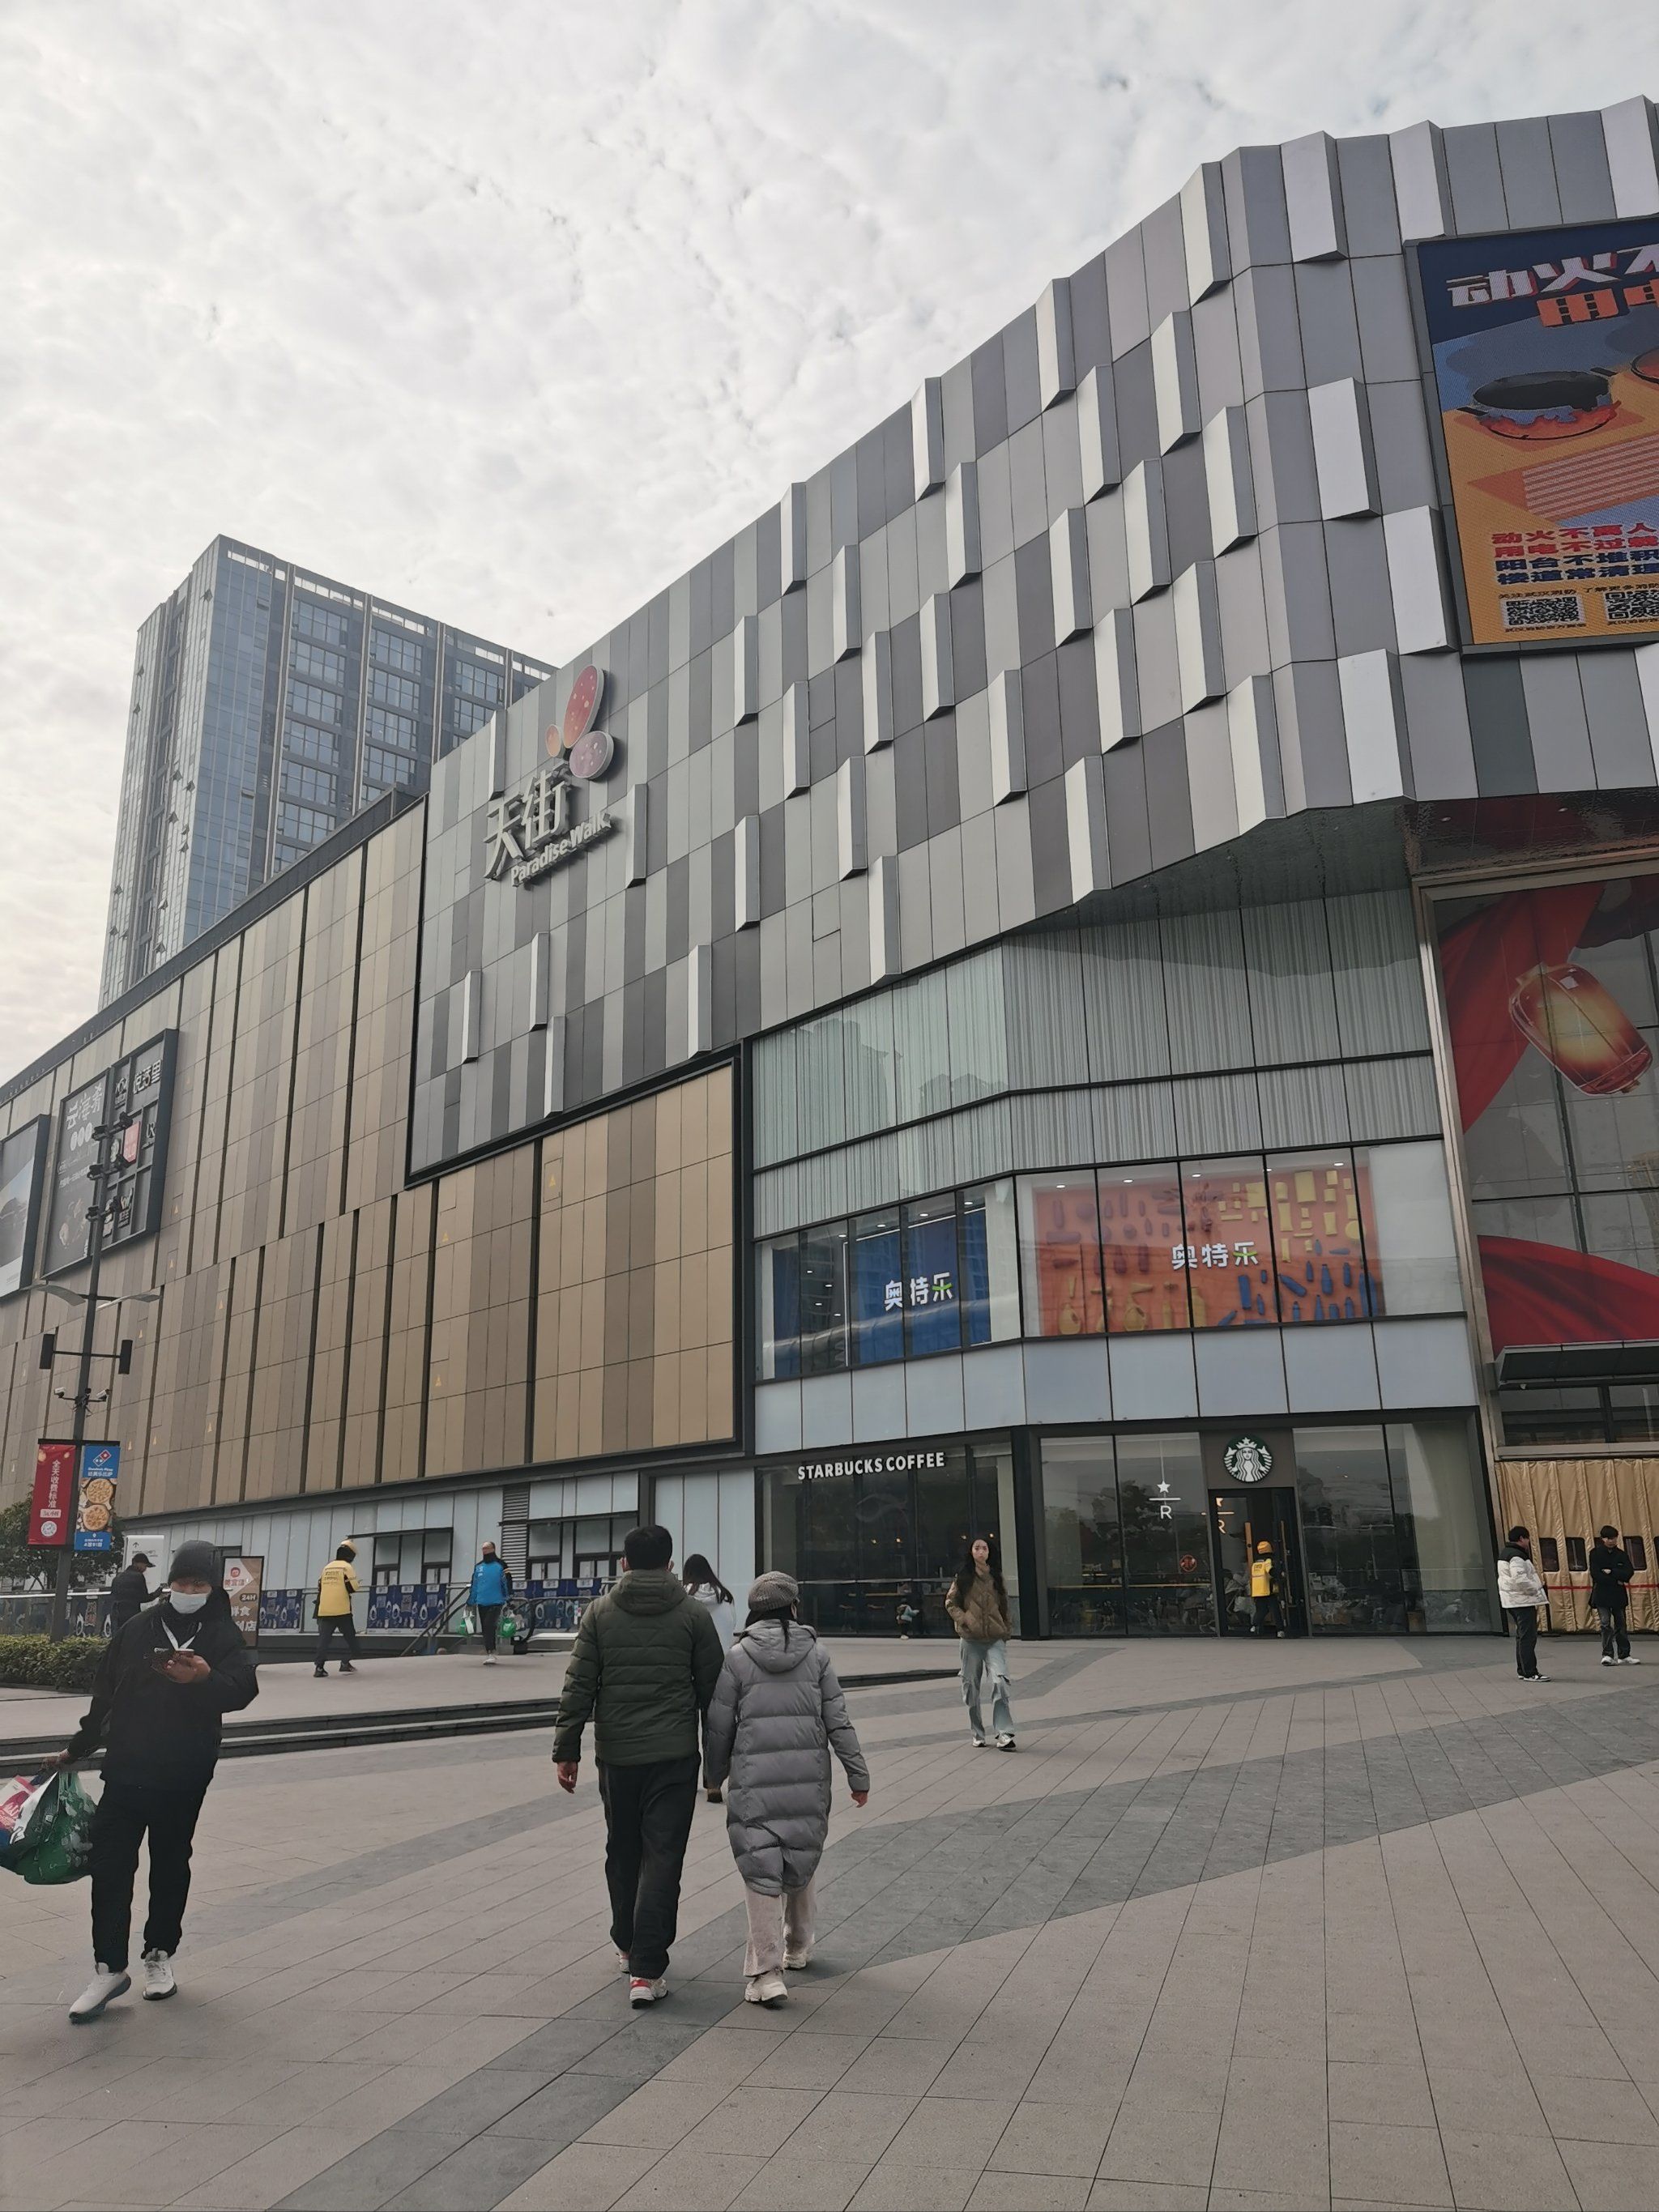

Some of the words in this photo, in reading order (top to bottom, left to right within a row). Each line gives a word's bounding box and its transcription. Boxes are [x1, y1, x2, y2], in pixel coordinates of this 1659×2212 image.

[484, 761, 569, 879] 天街
[511, 838, 566, 886] Paradise
[570, 812, 611, 848] Walk
[1171, 1242, 1258, 1270] 奥特乐
[884, 1272, 953, 1311] 奥特乐
[798, 1458, 883, 1480] STARBUCKS
[885, 1452, 945, 1472] COFFEE
